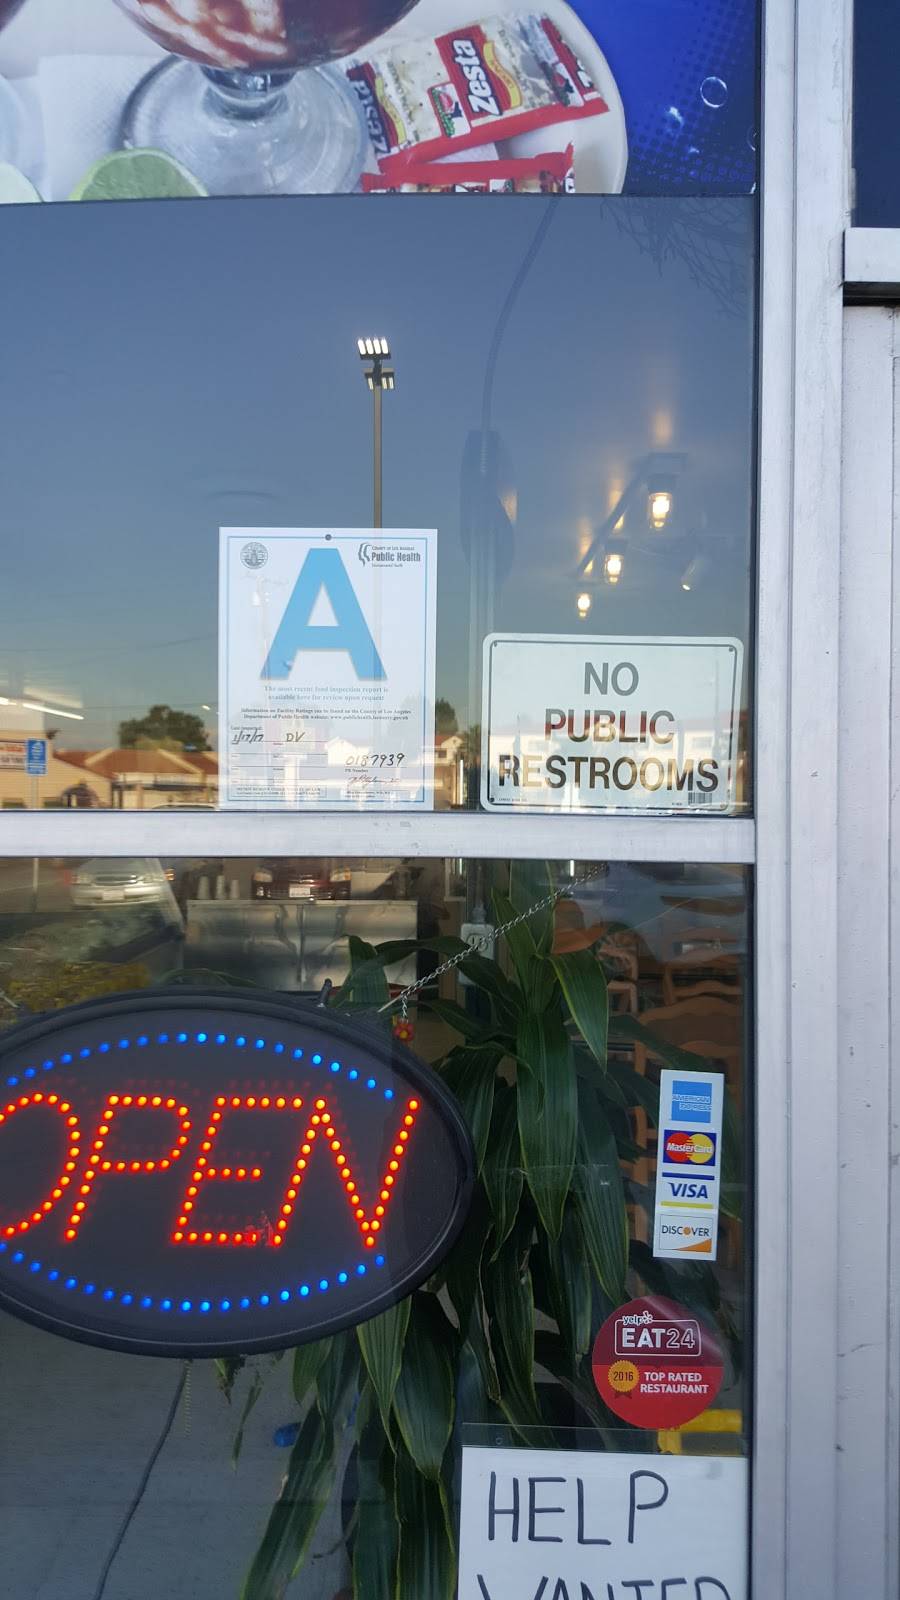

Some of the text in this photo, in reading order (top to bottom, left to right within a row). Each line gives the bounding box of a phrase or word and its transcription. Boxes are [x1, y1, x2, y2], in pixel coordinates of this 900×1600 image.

[453, 39, 503, 115] Zesta
[371, 552, 421, 562] Public Health
[259, 547, 388, 680] A
[583, 662, 639, 696] NO
[544, 708, 675, 744] PUBLIC
[345, 752, 405, 768] 0187939
[498, 754, 719, 793] RESTROOMS
[666, 1142, 713, 1153] MasterCard
[0, 1090, 422, 1248] OPEN
[667, 1182, 709, 1199] VISA
[661, 1225, 710, 1237] DISCOVER
[623, 1314, 643, 1326] yelp
[621, 1327, 696, 1349] EAT24
[613, 1371, 634, 1382] 2016
[643, 1371, 702, 1383] TOP RATED
[640, 1383, 709, 1394] RESTAURANT
[487, 1469, 669, 1545] HELP
